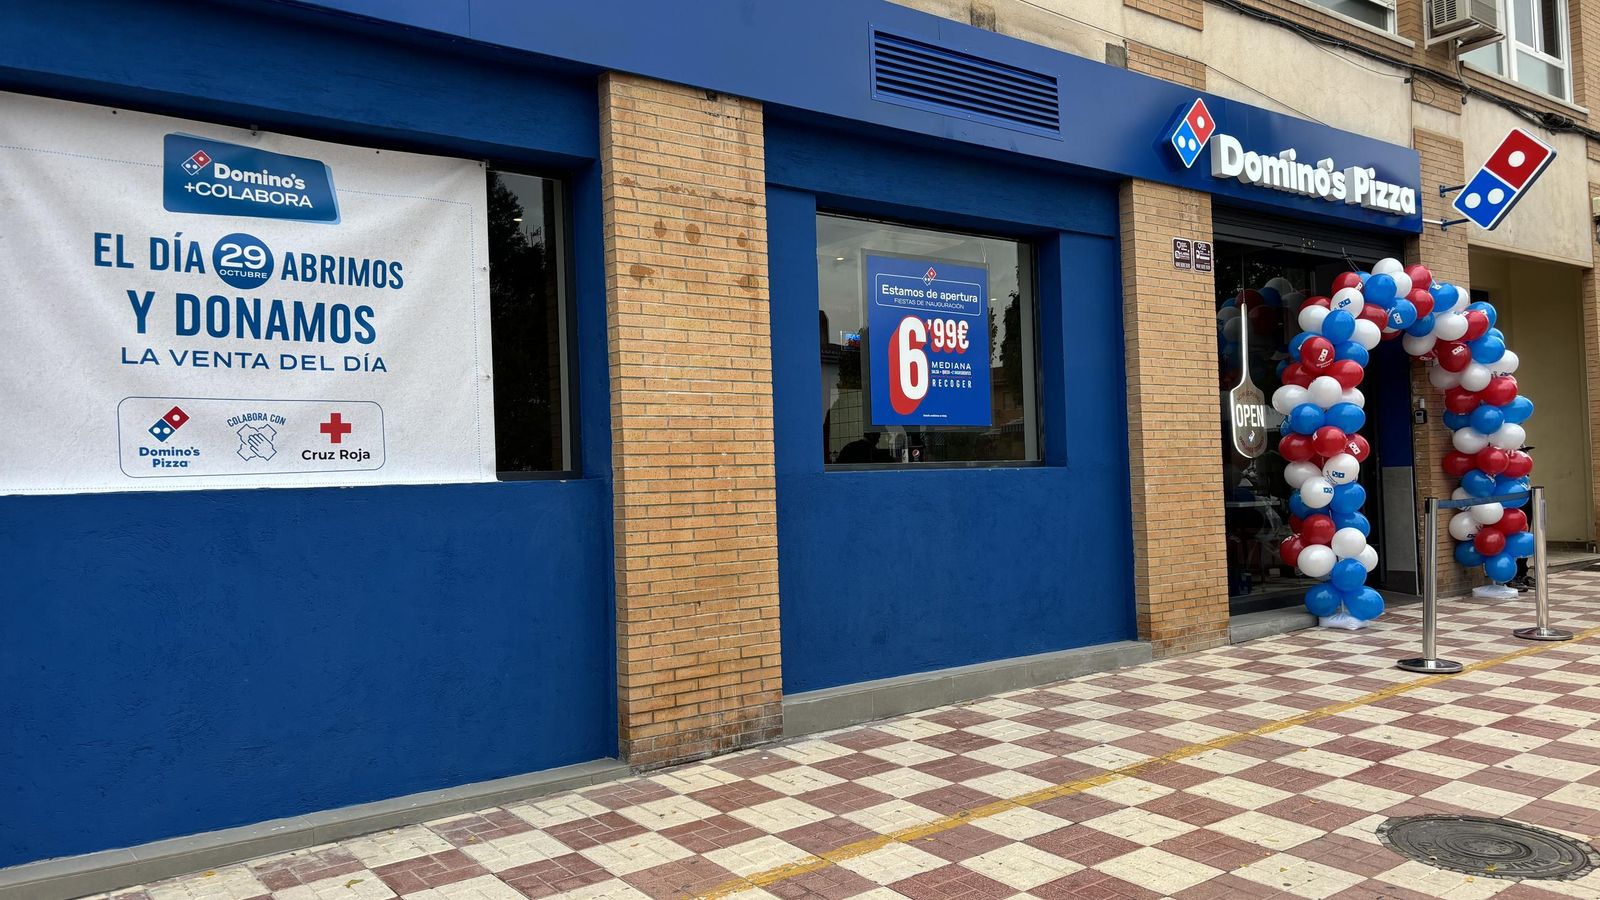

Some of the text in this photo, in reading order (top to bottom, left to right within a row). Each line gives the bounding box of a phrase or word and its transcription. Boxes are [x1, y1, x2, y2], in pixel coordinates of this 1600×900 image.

[213, 162, 306, 191] Domino's
[1212, 133, 1416, 215] Domino's Pizza
[184, 181, 314, 208] +COLABORA
[93, 231, 404, 290] EL DÍA 29 ABRIMOS
[219, 268, 268, 279] OCTUBRE
[881, 283, 978, 303] Estamos de apertura
[894, 298, 916, 306] FIESTAS
[126, 289, 377, 345] Y DONAMOS
[121, 346, 388, 373] LA VENTA DEL DÍA
[931, 361, 972, 370] MEDIANA
[932, 378, 972, 389] RECOGER
[226, 412, 287, 428] COLABORA CON
[1235, 403, 1265, 428] OPEN
[138, 446, 201, 457] Domino's
[301, 448, 371, 461] Cruz Roja
[152, 458, 189, 468] Pizza
